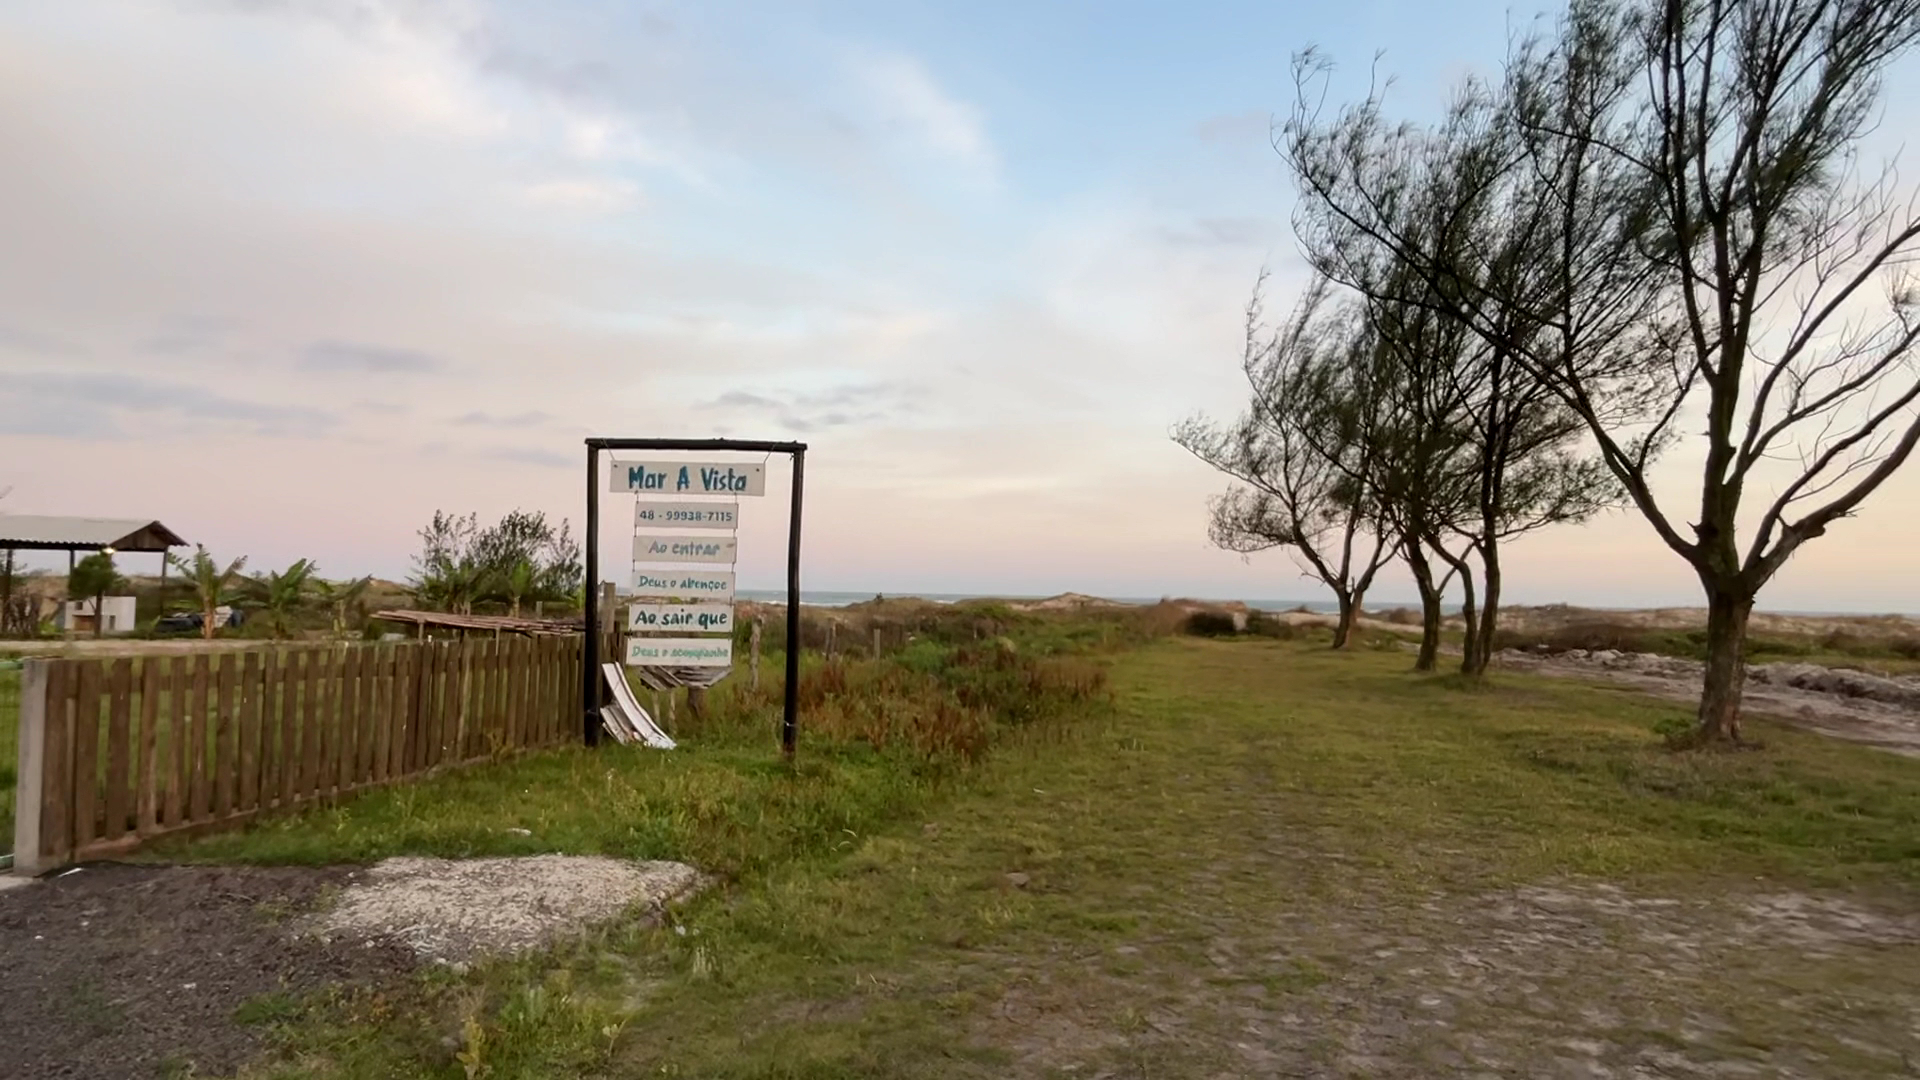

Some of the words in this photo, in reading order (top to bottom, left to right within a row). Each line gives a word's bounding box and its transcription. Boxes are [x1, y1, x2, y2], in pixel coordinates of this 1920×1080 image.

[628, 465, 667, 489] Mar
[677, 466, 690, 491] A
[700, 467, 747, 491] Vista
[640, 510, 654, 520] 48
[648, 540, 667, 554] Ao
[672, 541, 720, 556] entrar
[638, 575, 667, 588] Deus
[670, 580, 677, 588] o
[635, 610, 656, 625] Ao
[661, 608, 695, 626] sair
[698, 612, 728, 630] que
[632, 645, 658, 657] Deus
